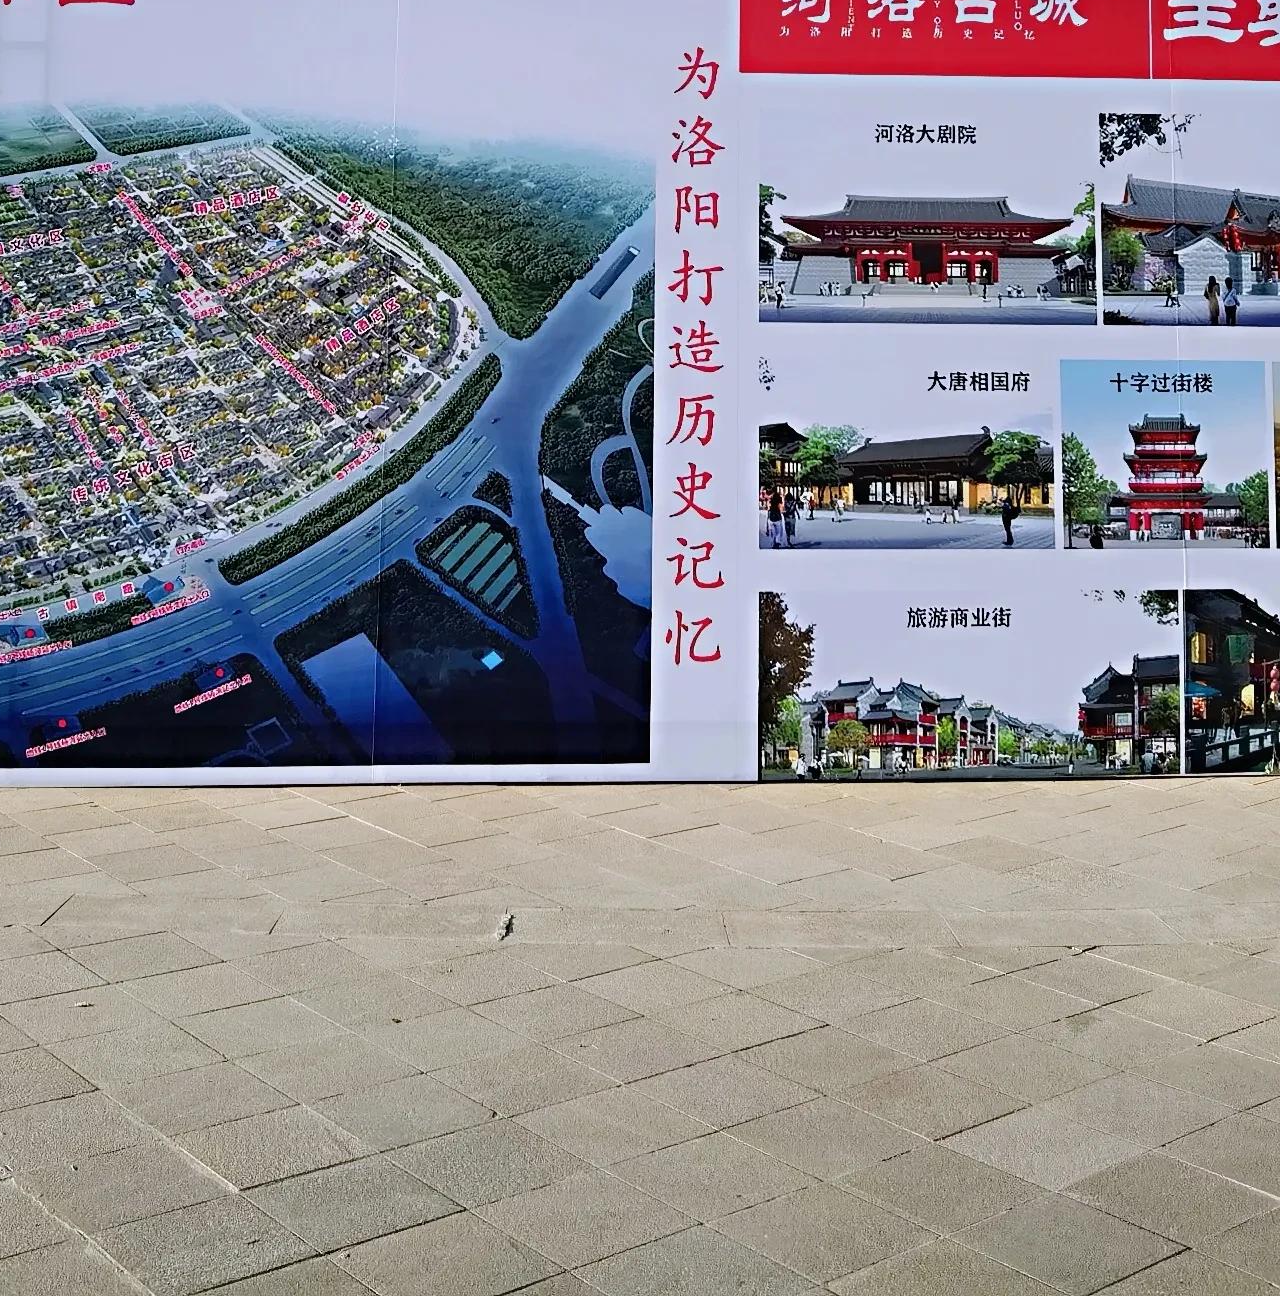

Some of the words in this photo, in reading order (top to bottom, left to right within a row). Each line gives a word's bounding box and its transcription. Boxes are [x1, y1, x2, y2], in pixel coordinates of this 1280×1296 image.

[875, 124, 977, 145] 河洛大剧院
[192, 186, 281, 216] 精品酒店区
[325, 298, 400, 353] 精品酒店区
[665, 46, 726, 666] 为洛阳打造历史记忆
[927, 371, 1031, 393] 大唐相国府
[1109, 372, 1213, 394] 十字过街楼
[70, 443, 198, 505] 传统文化街区
[907, 606, 1011, 628] 旅游商业街
